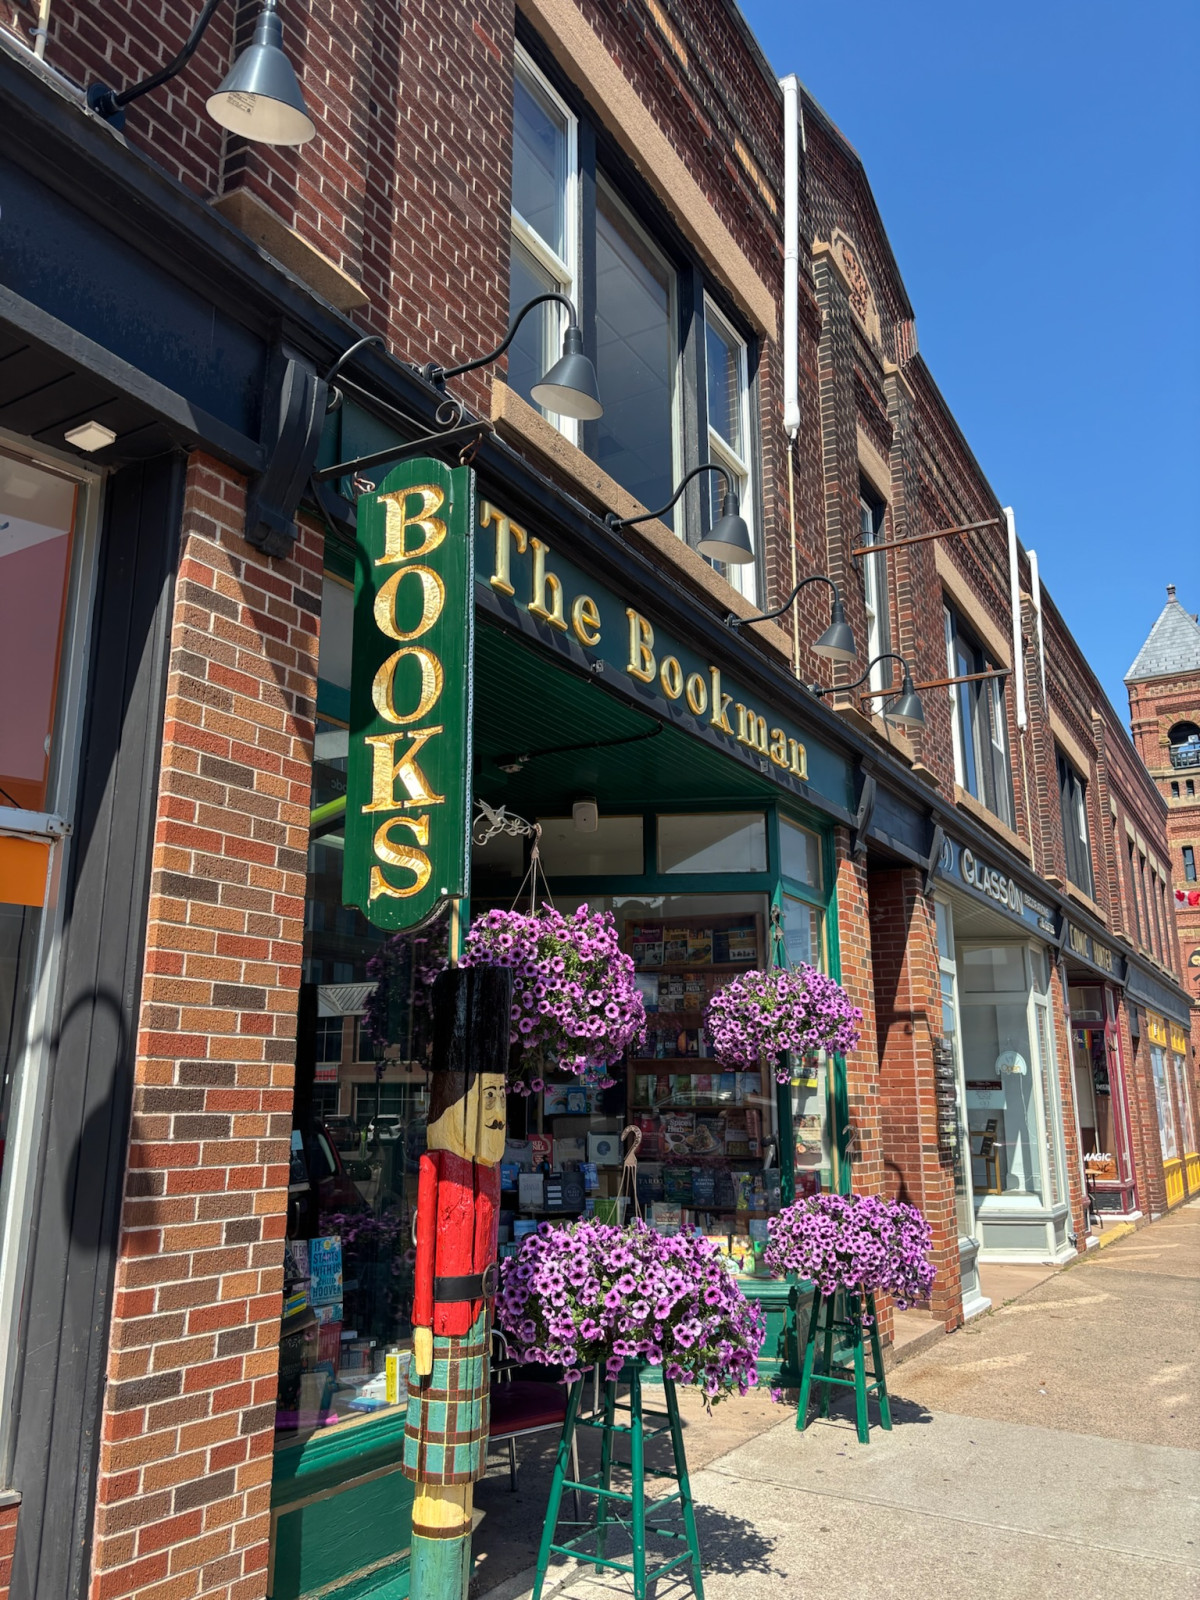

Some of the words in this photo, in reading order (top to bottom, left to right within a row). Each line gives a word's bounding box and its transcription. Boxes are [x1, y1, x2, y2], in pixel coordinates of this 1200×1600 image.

[480, 500, 601, 646] The
[626, 607, 809, 780] Bookman
[361, 484, 447, 900] BOOKS
[961, 848, 1024, 915] GLASSON
[1069, 923, 1089, 958] COMIC
[1092, 939, 1113, 972] HUNTER
[1001, 1064, 1021, 1075] Open
[1083, 1152, 1112, 1162] MAGIC
[314, 1240, 321, 1252] IT
[313, 1252, 338, 1265] STARTS
[313, 1264, 332, 1277] WITH
[334, 1263, 341, 1274] US
